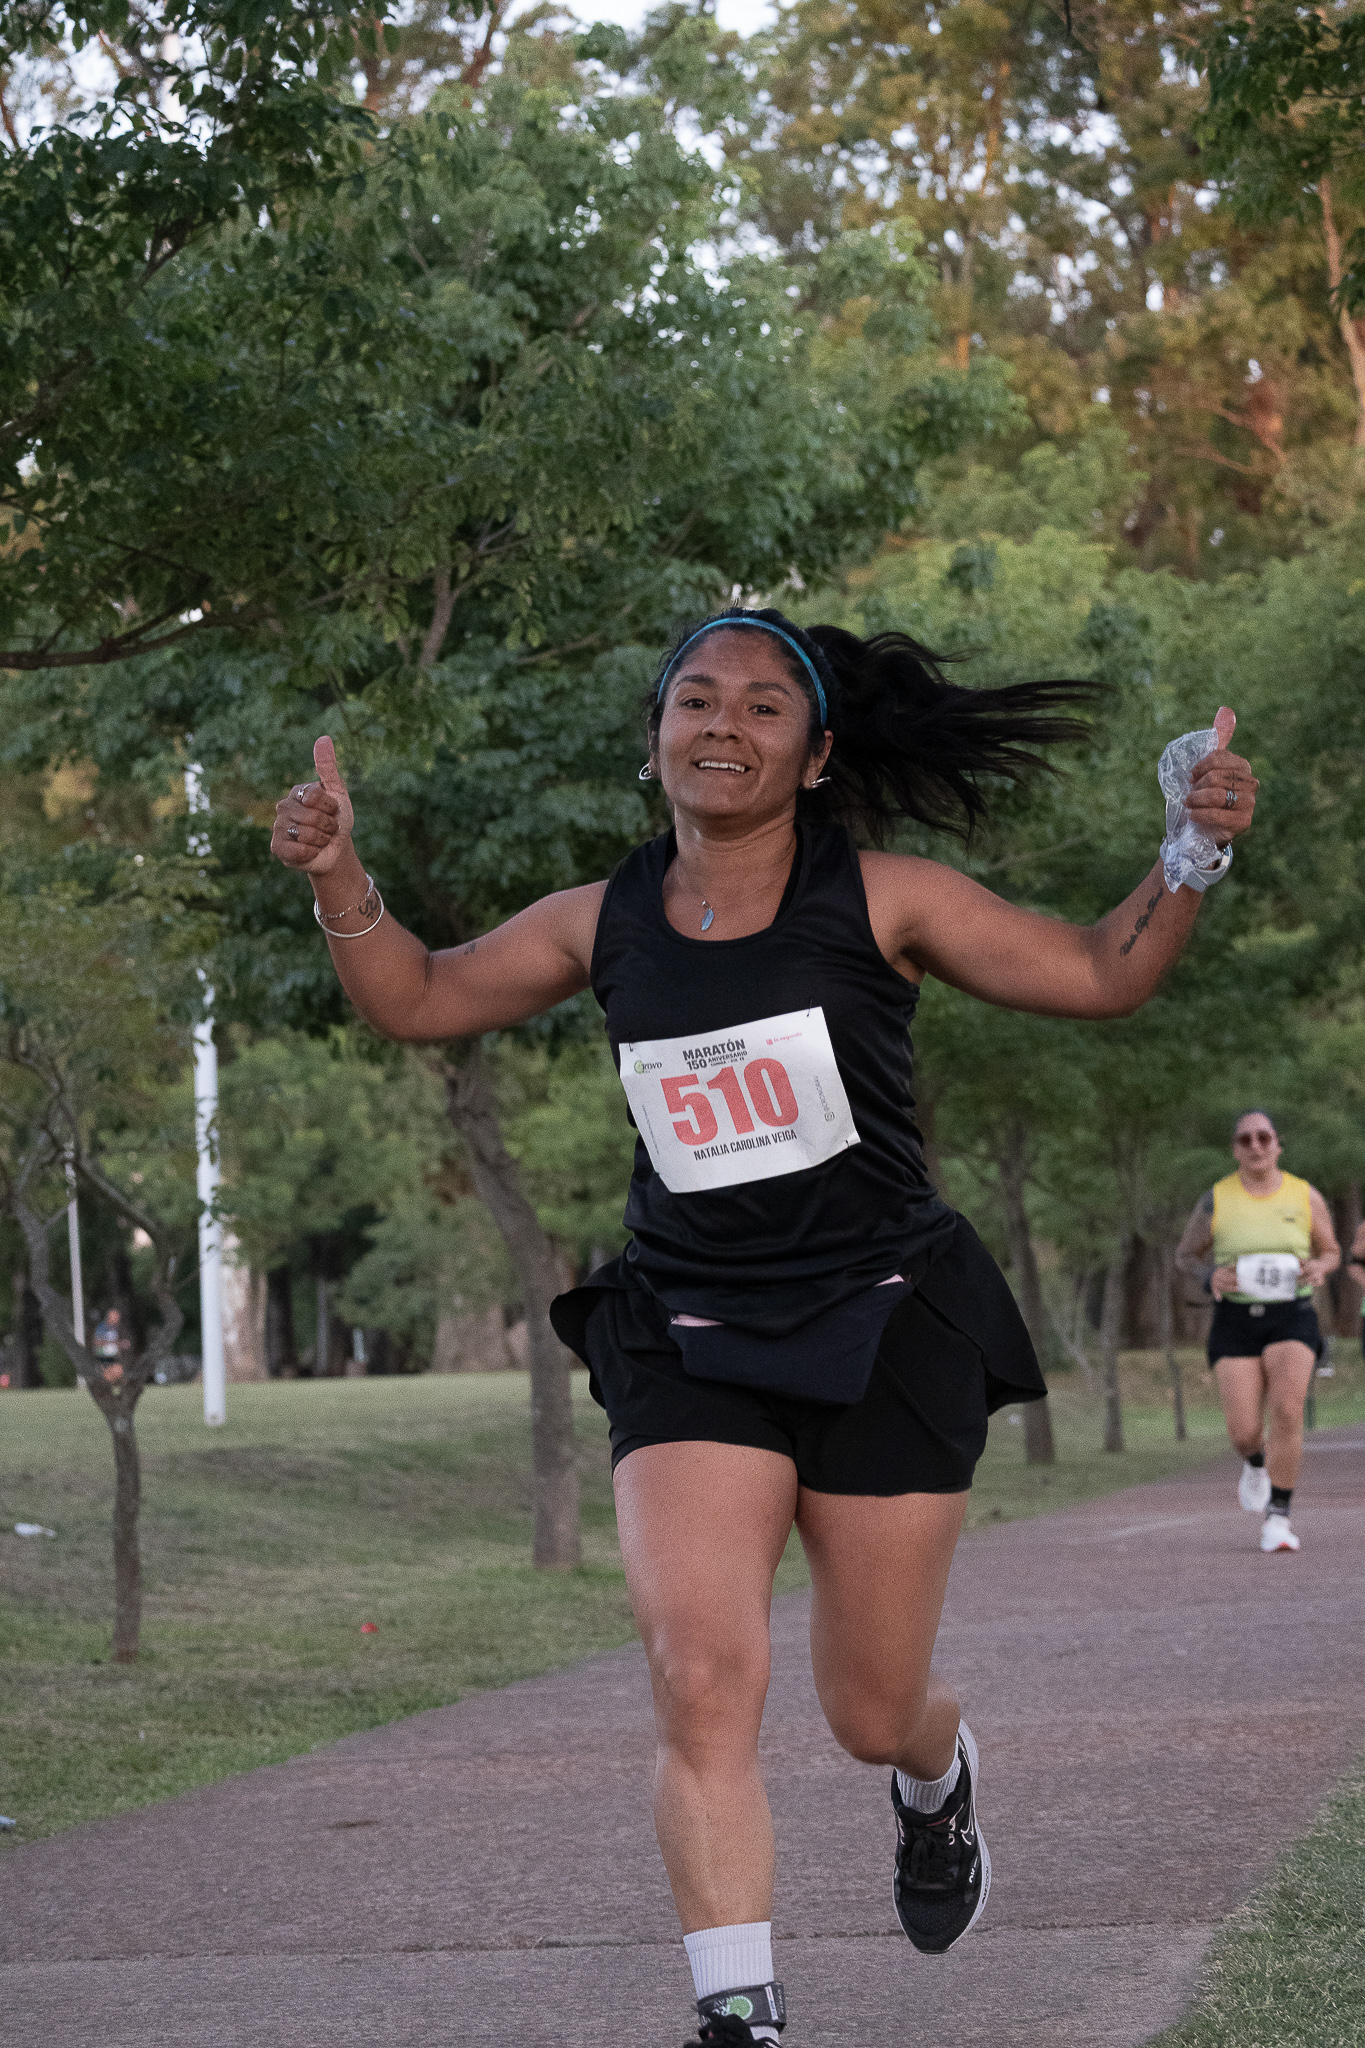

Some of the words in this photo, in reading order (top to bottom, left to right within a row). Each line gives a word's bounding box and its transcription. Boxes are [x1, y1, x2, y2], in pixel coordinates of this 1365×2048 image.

[683, 1039, 746, 1061] MARATÓN
[687, 1059, 707, 1071] 150
[708, 1051, 748, 1063] ANIVERSARIO
[660, 1057, 799, 1146] 510
[694, 1146, 730, 1161] NATALIA
[730, 1135, 771, 1155] CAROLINA
[772, 1129, 798, 1143] VEIGA
